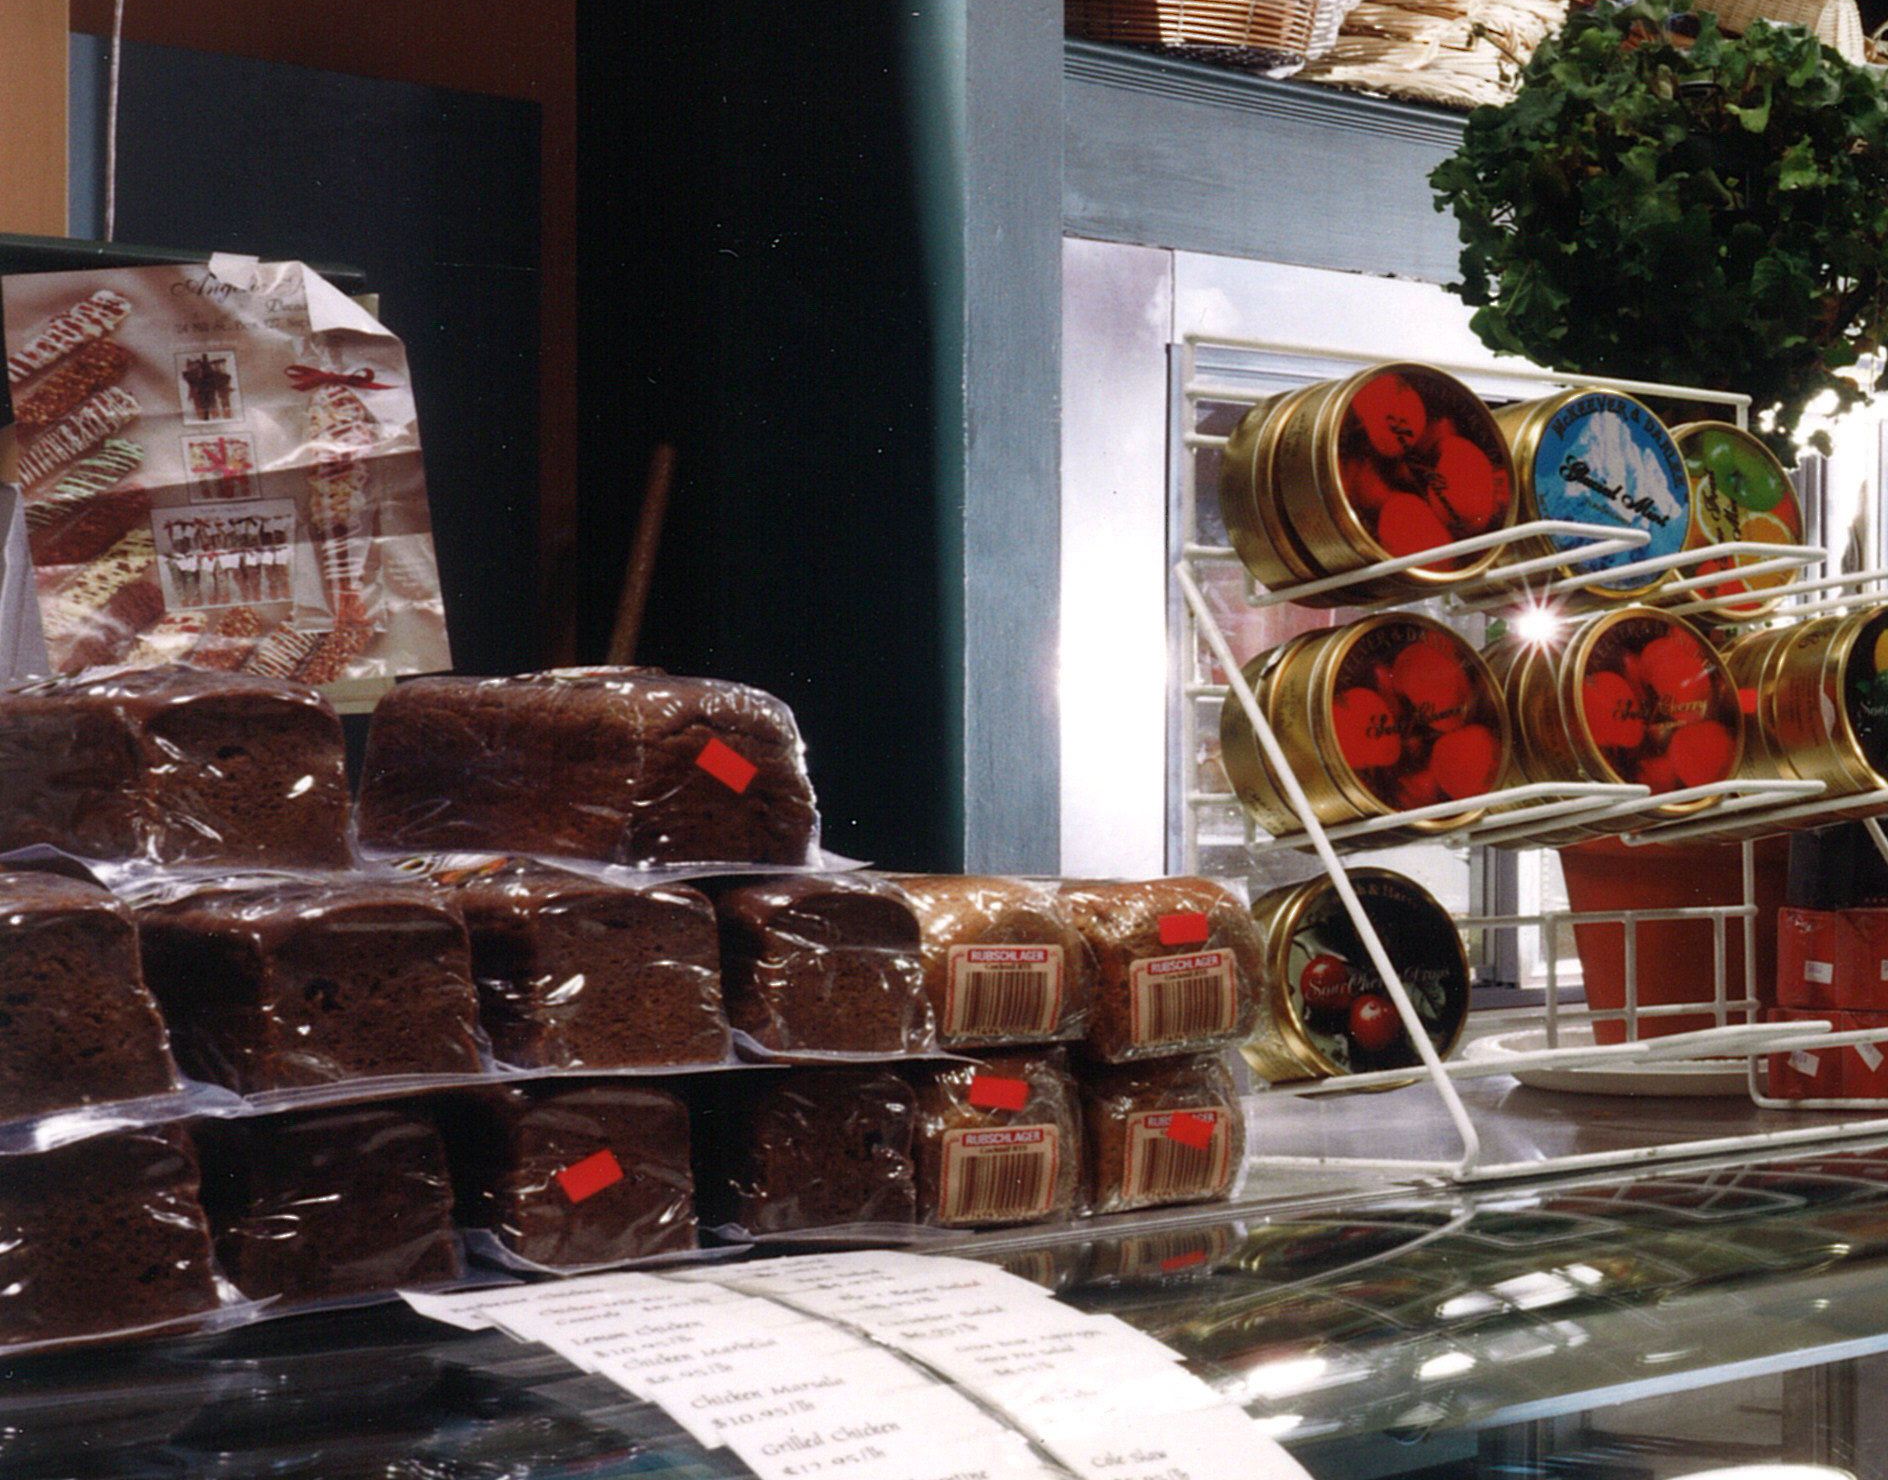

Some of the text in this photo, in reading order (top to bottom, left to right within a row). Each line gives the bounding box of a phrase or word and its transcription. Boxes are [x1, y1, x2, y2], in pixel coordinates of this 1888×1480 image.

[970, 950, 1045, 963] RUBSCHLAGER
[1150, 954, 1218, 973] RUBSCHLAGER
[965, 1129, 1041, 1144] RUBSCHLAGER
[690, 1375, 847, 1410] Chicken Marsala
[760, 1419, 902, 1457] Grilled Chicken
[1090, 1449, 1128, 1469] Cole
